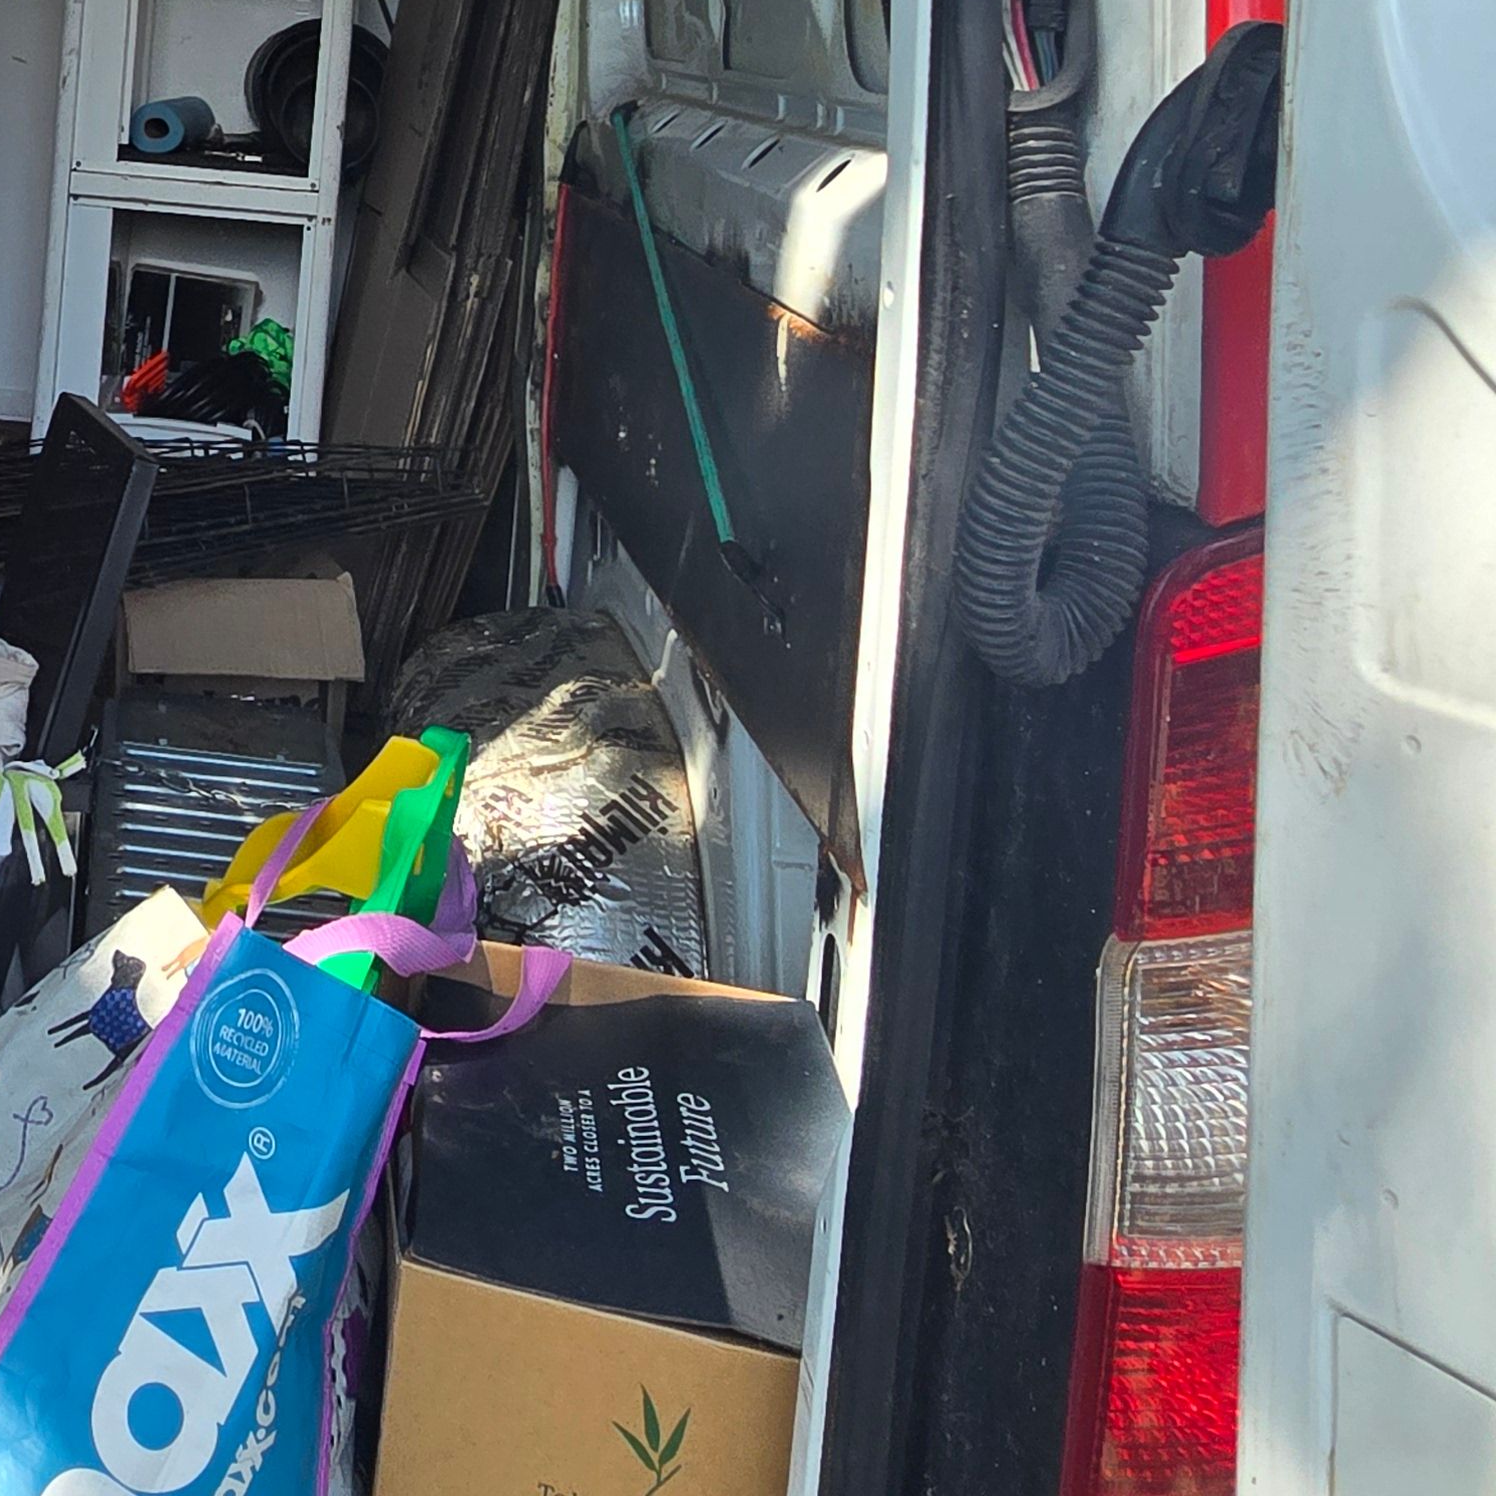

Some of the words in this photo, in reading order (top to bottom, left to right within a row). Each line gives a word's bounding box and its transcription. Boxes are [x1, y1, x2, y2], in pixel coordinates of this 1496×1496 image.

[237, 1007, 274, 1038] 100%
[219, 1024, 269, 1057] RECYCLED
[212, 1042, 263, 1075] MATERIAL
[577, 1089, 592, 1097] A
[577, 1098, 594, 1112] TO
[558, 1099, 577, 1144] MILLION
[580, 1113, 600, 1154] CLOSER
[562, 1145, 579, 1172] TWO
[606, 1066, 678, 1223] Sustainable
[676, 1092, 730, 1193] Future
[585, 1156, 603, 1192] ACRES
